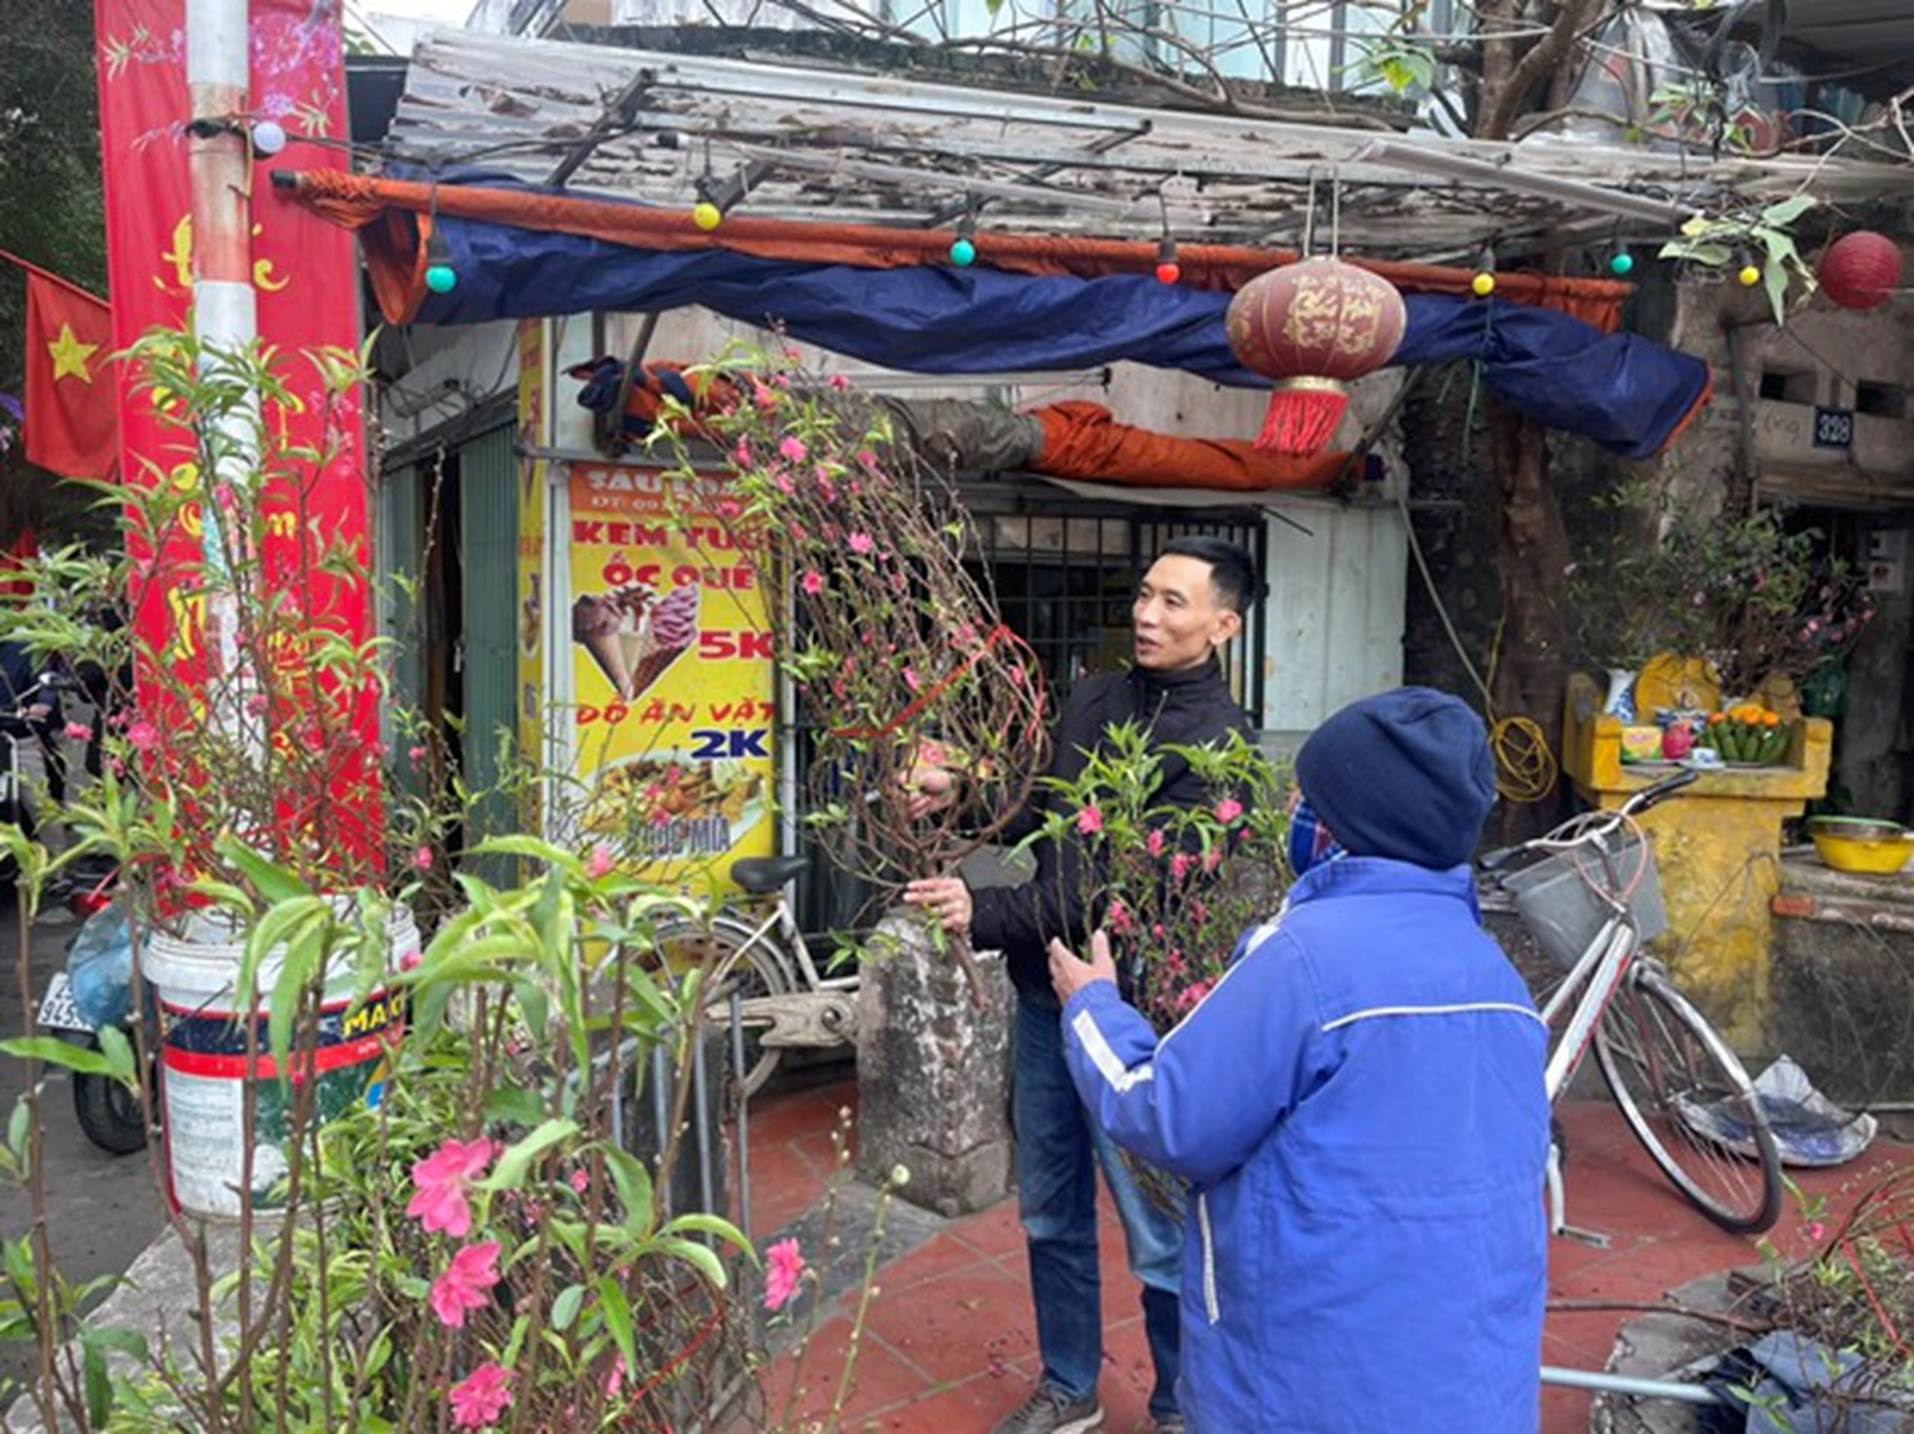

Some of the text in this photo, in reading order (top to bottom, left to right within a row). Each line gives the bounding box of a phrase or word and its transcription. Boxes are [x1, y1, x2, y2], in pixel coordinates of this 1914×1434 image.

[573, 521, 668, 545] KEM
[698, 631, 775, 660] 5K
[691, 729, 770, 759] 2K
